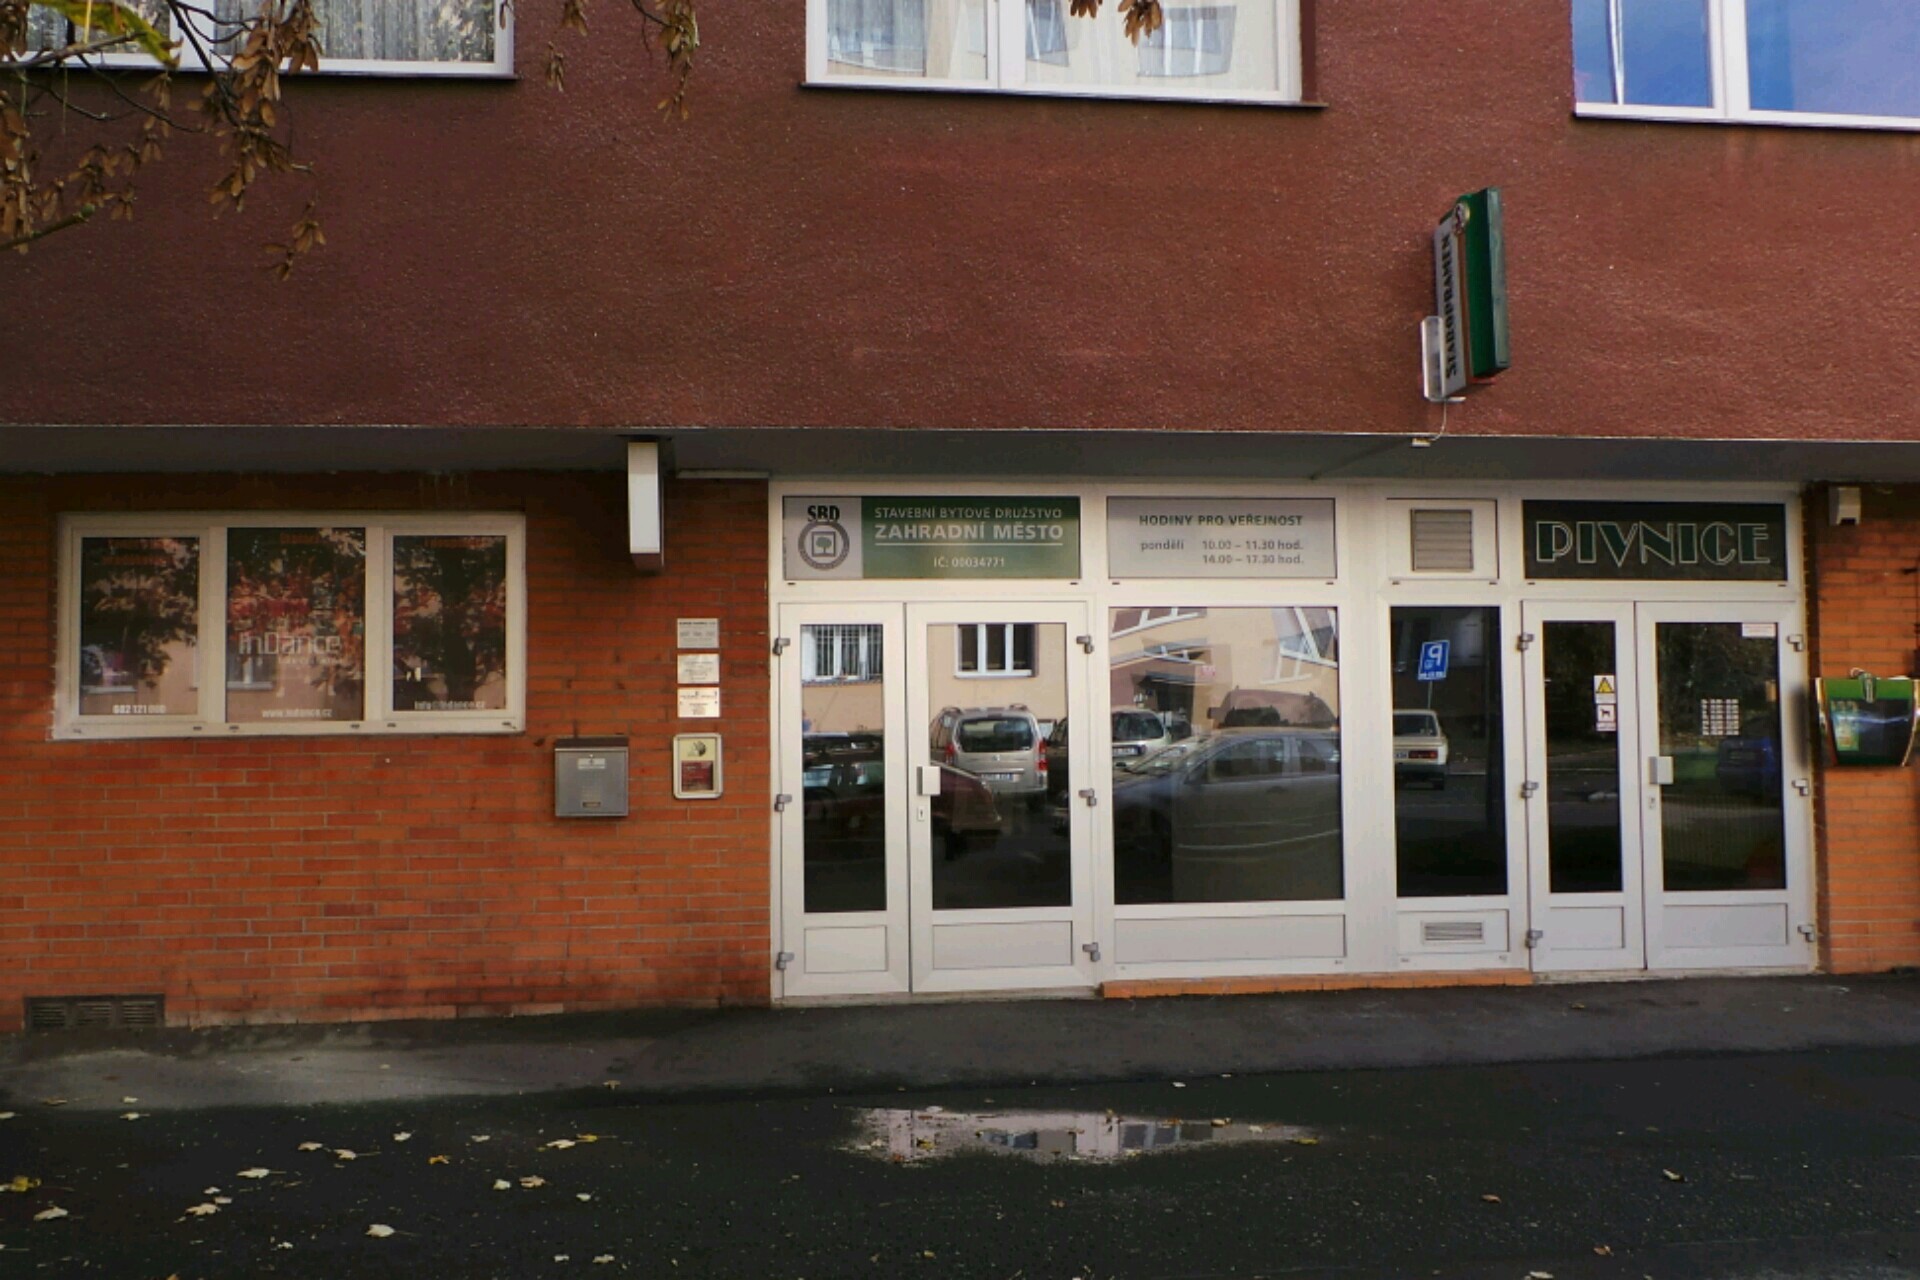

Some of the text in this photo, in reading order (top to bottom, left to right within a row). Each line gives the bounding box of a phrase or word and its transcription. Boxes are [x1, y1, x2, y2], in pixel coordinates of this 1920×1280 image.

[807, 505, 840, 522] SBD
[874, 506, 936, 519] STAVEBNÍ
[1139, 513, 1303, 526] HODINY PRO VEŘEJNOST
[875, 521, 1063, 539] ZAHRADNÍ MĚSTO
[1277, 539, 1304, 551] hod.
[1536, 521, 1771, 567] PIVNICE
